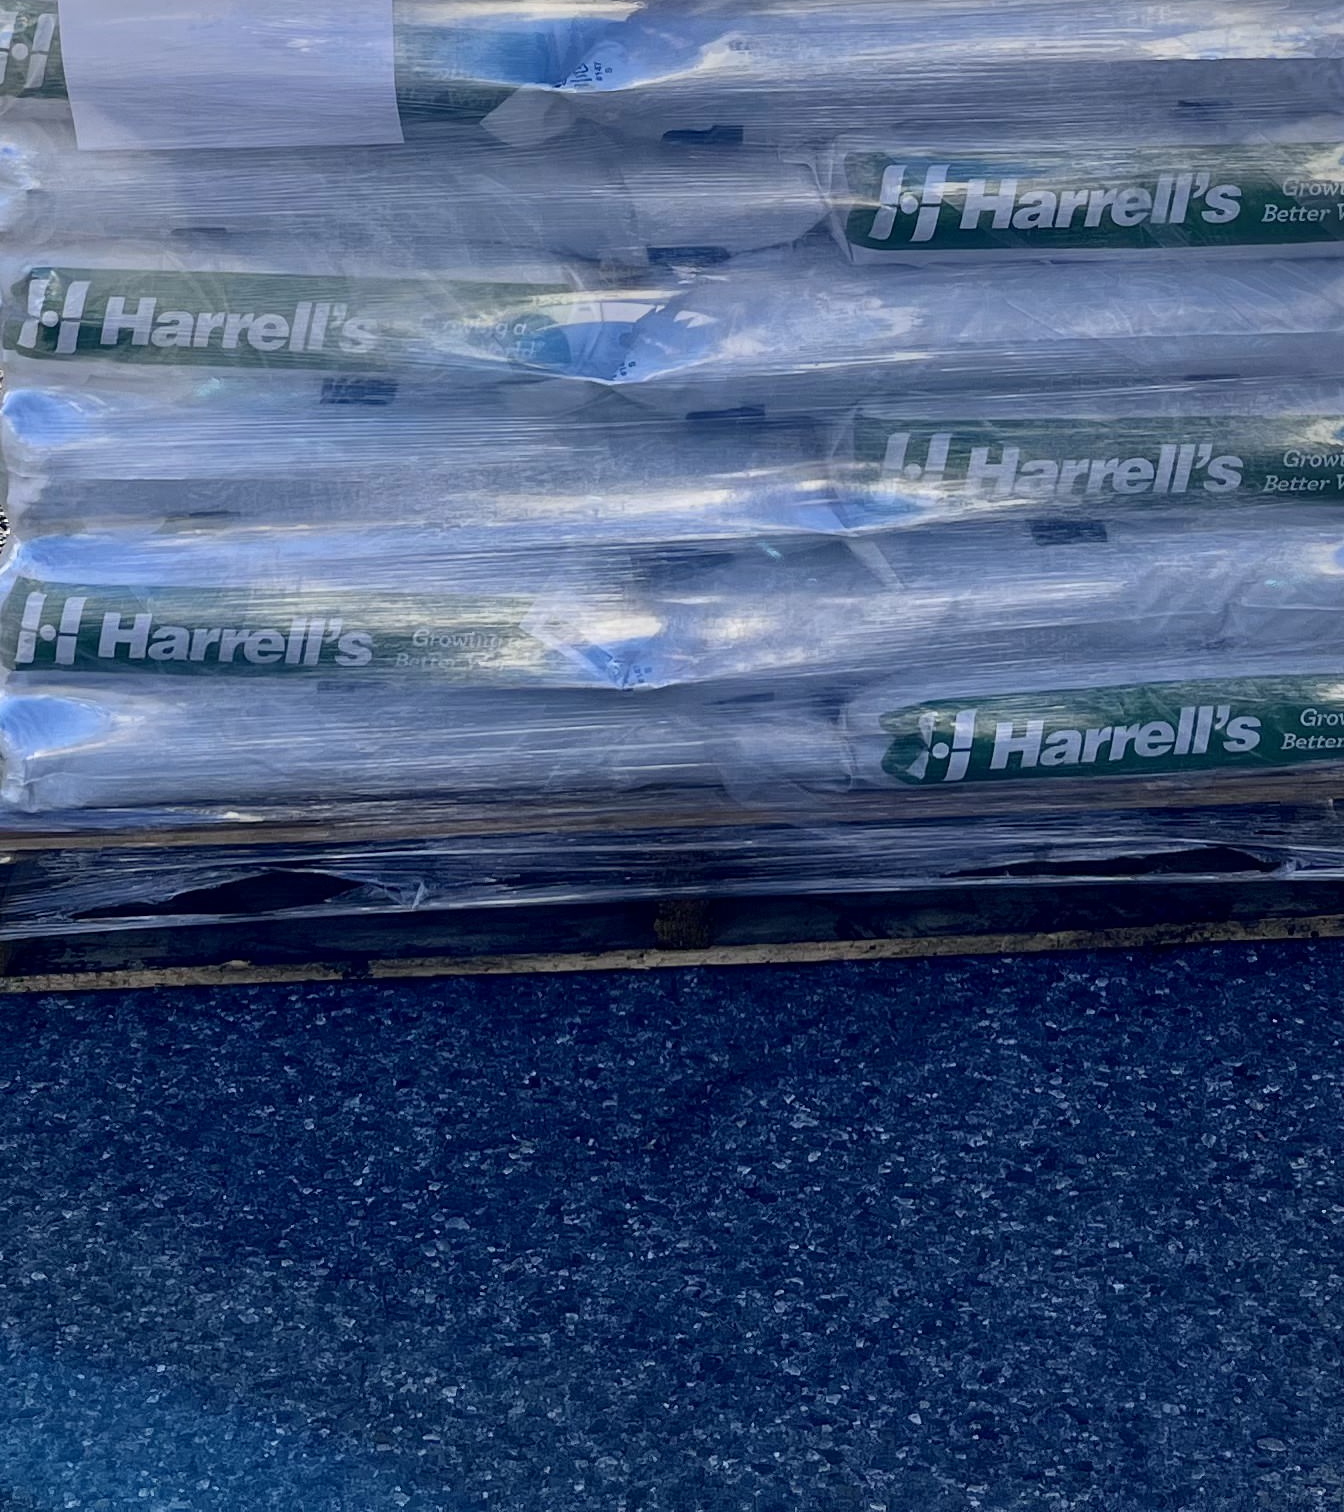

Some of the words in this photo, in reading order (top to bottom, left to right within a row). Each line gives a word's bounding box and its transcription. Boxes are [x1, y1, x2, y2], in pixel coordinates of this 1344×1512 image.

[959, 172, 1241, 230] Harrell's
[1261, 204, 1331, 222] Better
[100, 296, 380, 354] Harrell's
[963, 443, 1245, 496] Harrell's
[1263, 475, 1331, 492] Better
[97, 611, 373, 667] Harrell's
[989, 704, 1262, 770] Harrell's
